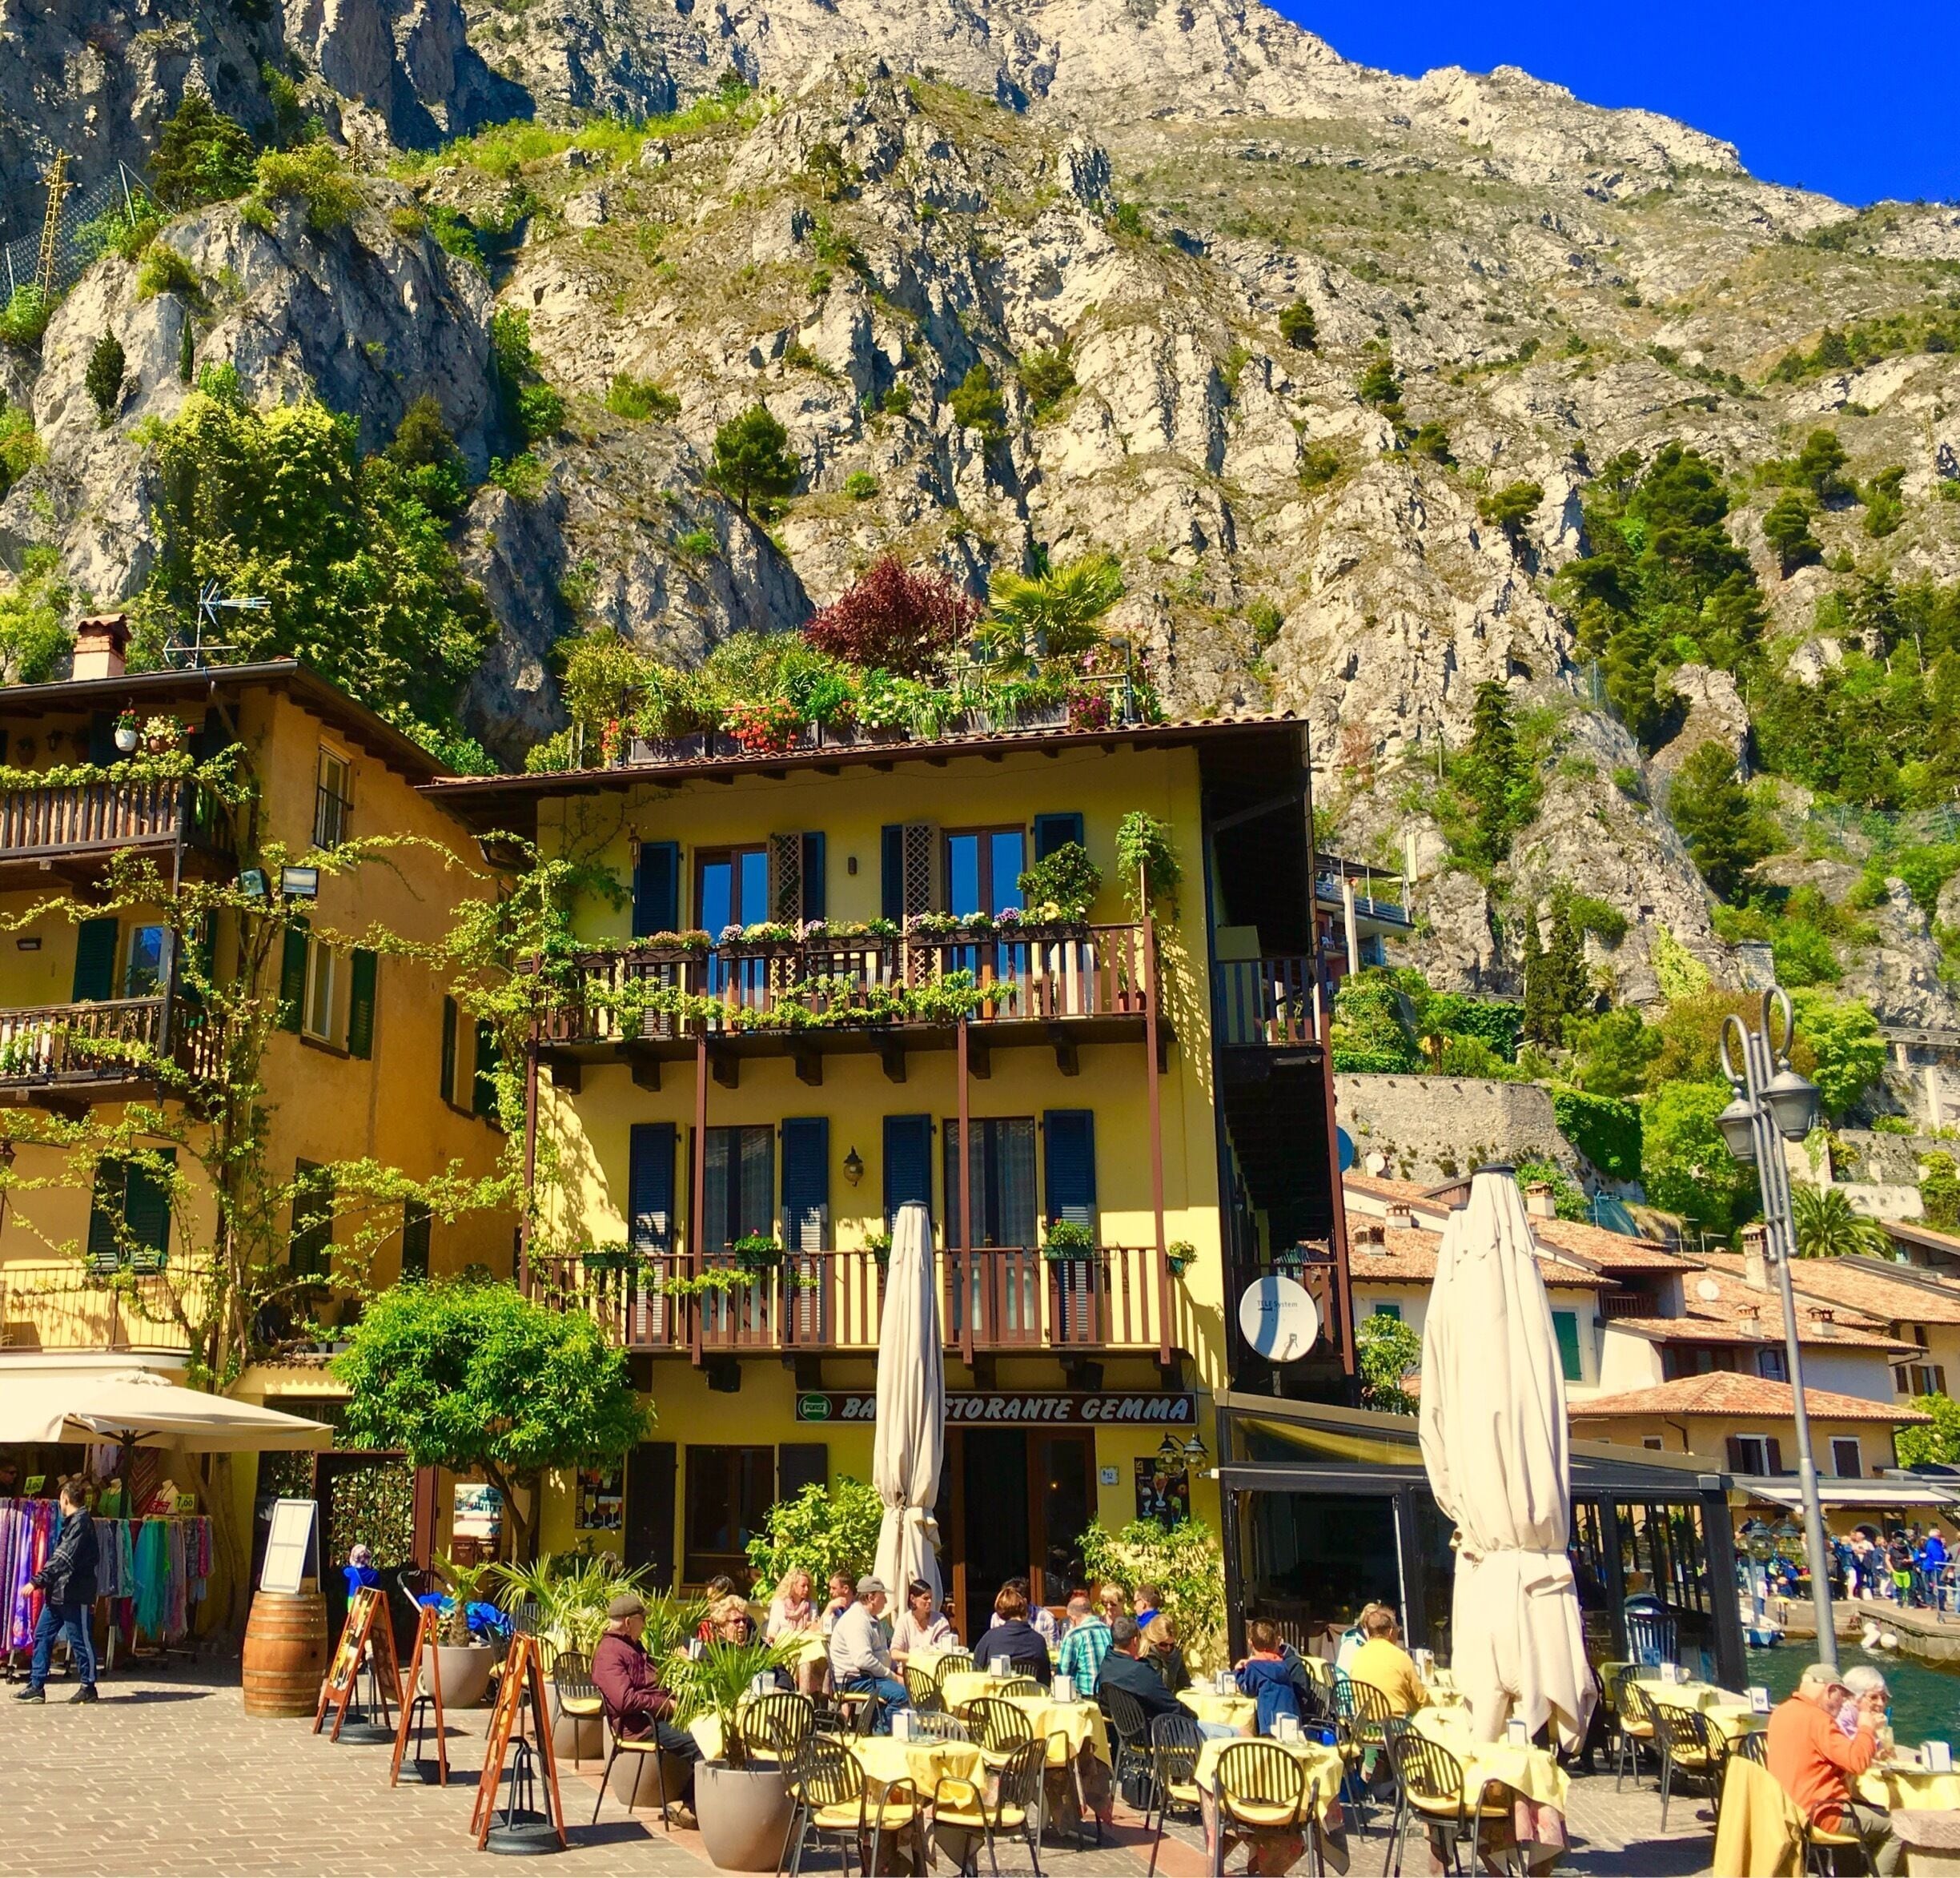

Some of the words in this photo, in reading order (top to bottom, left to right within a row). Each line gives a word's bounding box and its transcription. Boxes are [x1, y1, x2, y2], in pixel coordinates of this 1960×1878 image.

[841, 1397, 877, 1419] BA
[1081, 1398, 1188, 1420] GEMMA
[177, 1496, 193, 1507] 7,00
